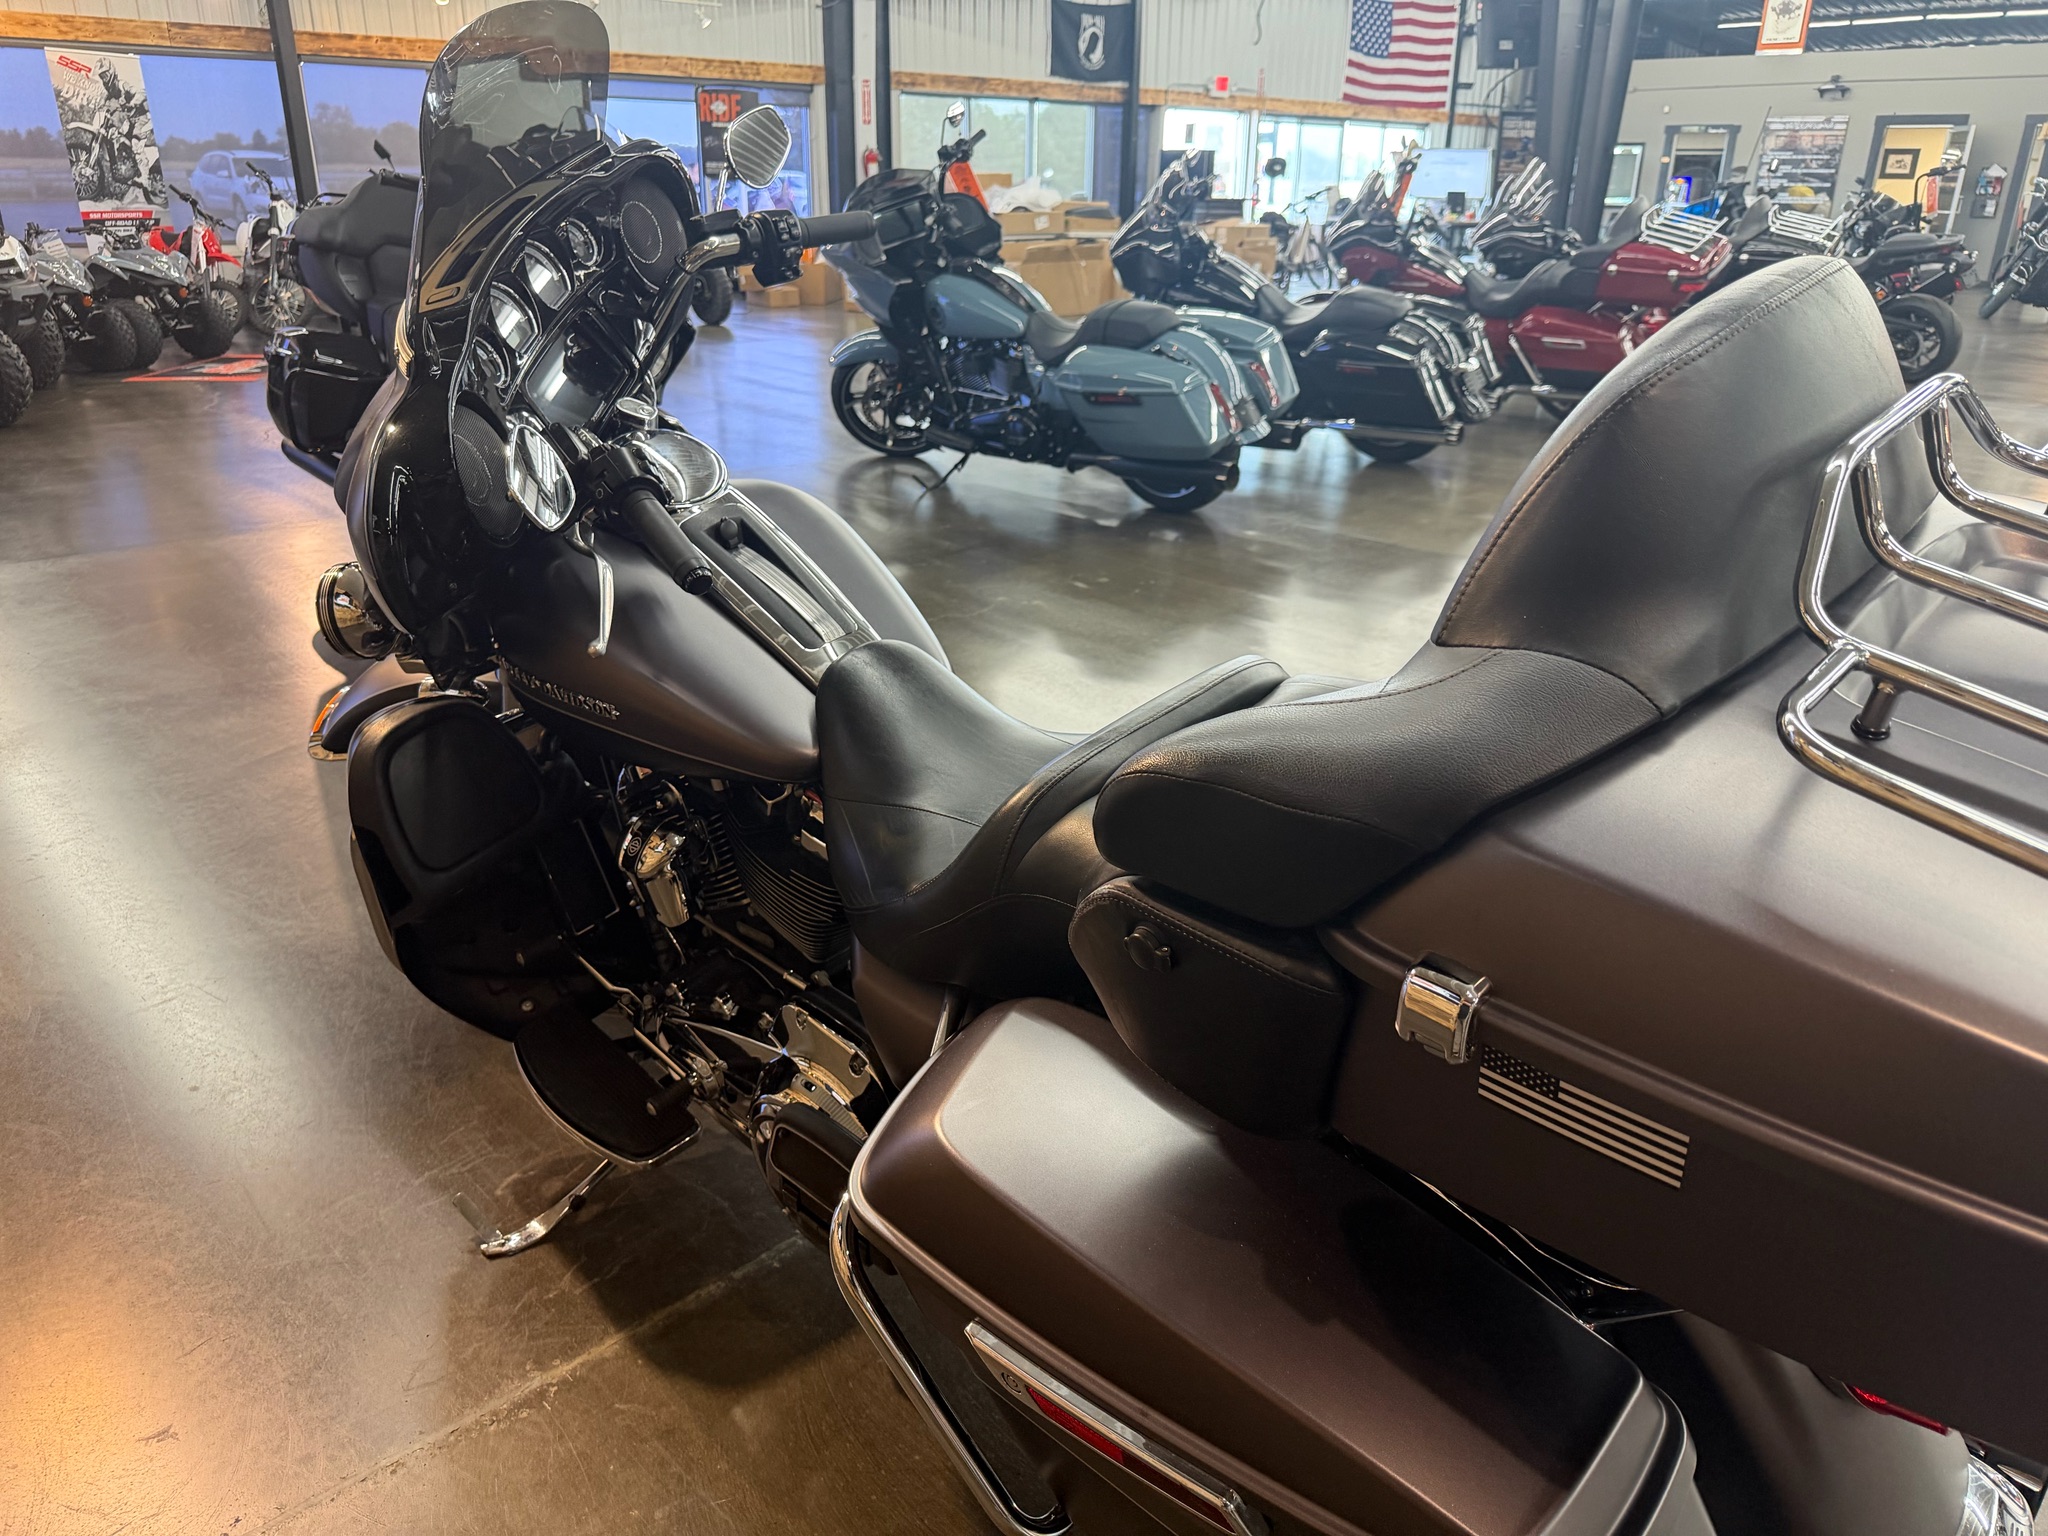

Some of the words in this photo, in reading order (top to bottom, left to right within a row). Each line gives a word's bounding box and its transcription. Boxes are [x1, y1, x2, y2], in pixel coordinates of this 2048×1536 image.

[57, 55, 92, 79] SSR
[699, 91, 742, 122] RIDE
[102, 211, 143, 219] MOTORSPORTS
